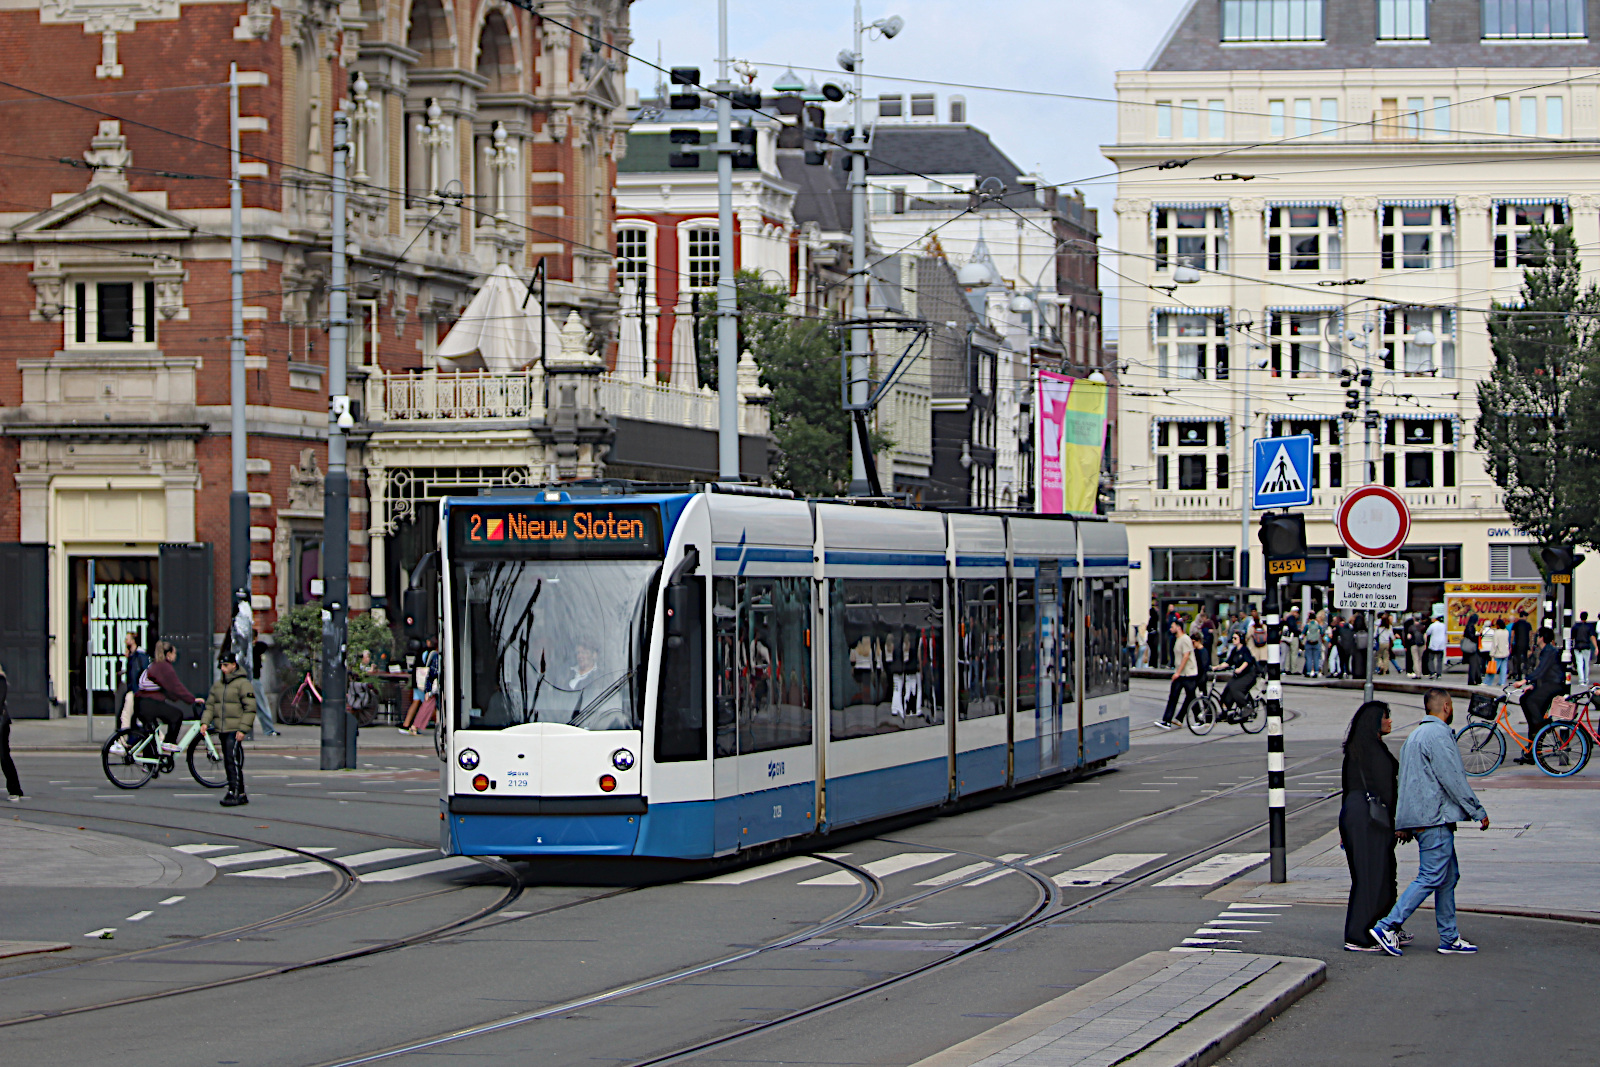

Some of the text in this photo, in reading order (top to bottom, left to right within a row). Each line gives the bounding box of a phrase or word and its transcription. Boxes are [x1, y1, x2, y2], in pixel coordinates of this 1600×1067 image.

[470, 512, 644, 540] 2 Nieuw Sloten
[1488, 528, 1510, 536] GWK
[1272, 560, 1302, 572] 545-V
[1340, 560, 1407, 570] Uitgezonderd Trams,
[1336, 568, 1370, 577] Ljnbussen
[1382, 570, 1408, 578] Fietsers
[1348, 580, 1392, 590] Uitgezonderd
[1344, 591, 1364, 599] Laden
[91, 584, 148, 619] JE KUNT
[1474, 600, 1512, 613] SORRY
[91, 620, 114, 655] HET
